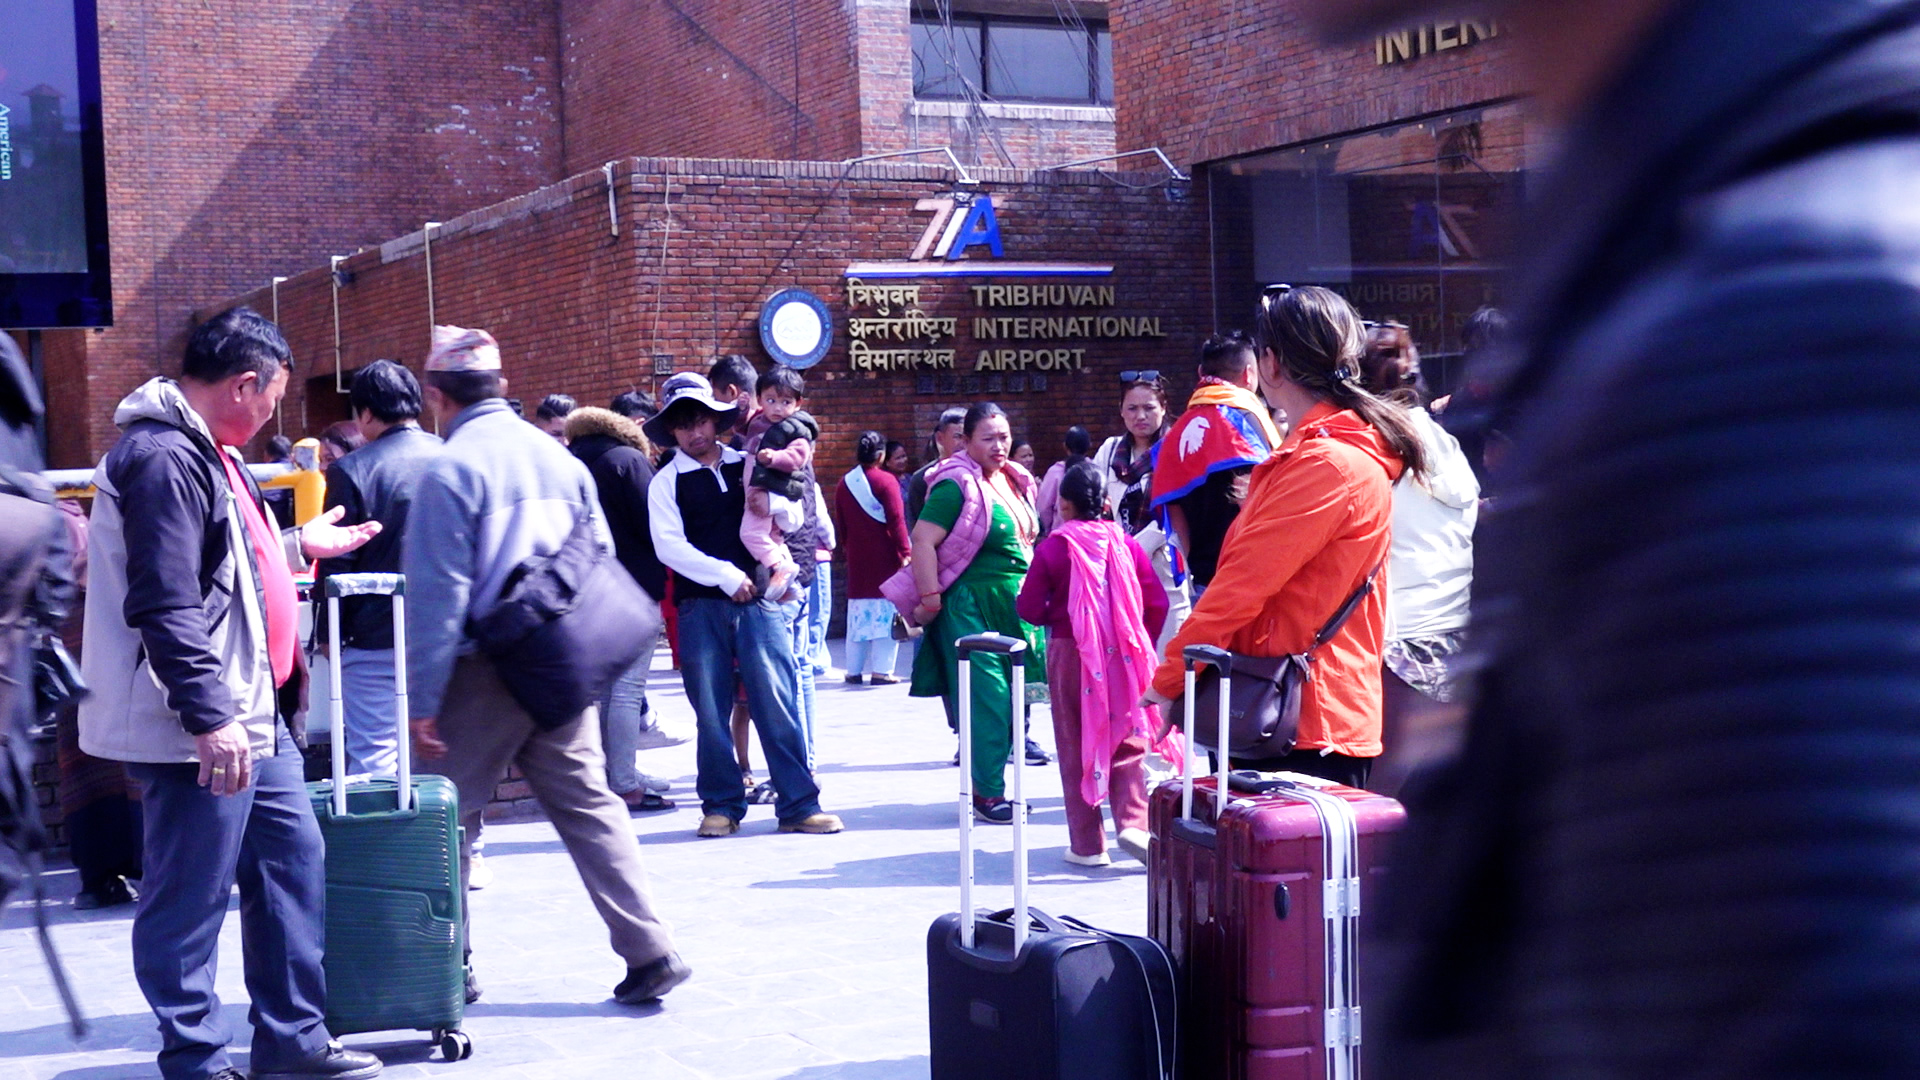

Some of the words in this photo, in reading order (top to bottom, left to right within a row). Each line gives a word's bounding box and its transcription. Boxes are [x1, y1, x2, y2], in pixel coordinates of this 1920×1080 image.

[0, 103, 14, 180] American
[909, 195, 1006, 261] TIA
[846, 277, 920, 316] त्रिभुवन
[972, 284, 1115, 307] TRIBHUVAN
[974, 316, 1168, 339] INTERNATIONAL
[849, 339, 955, 371] विमानस्थल
[974, 348, 1086, 371] AIRPORT
